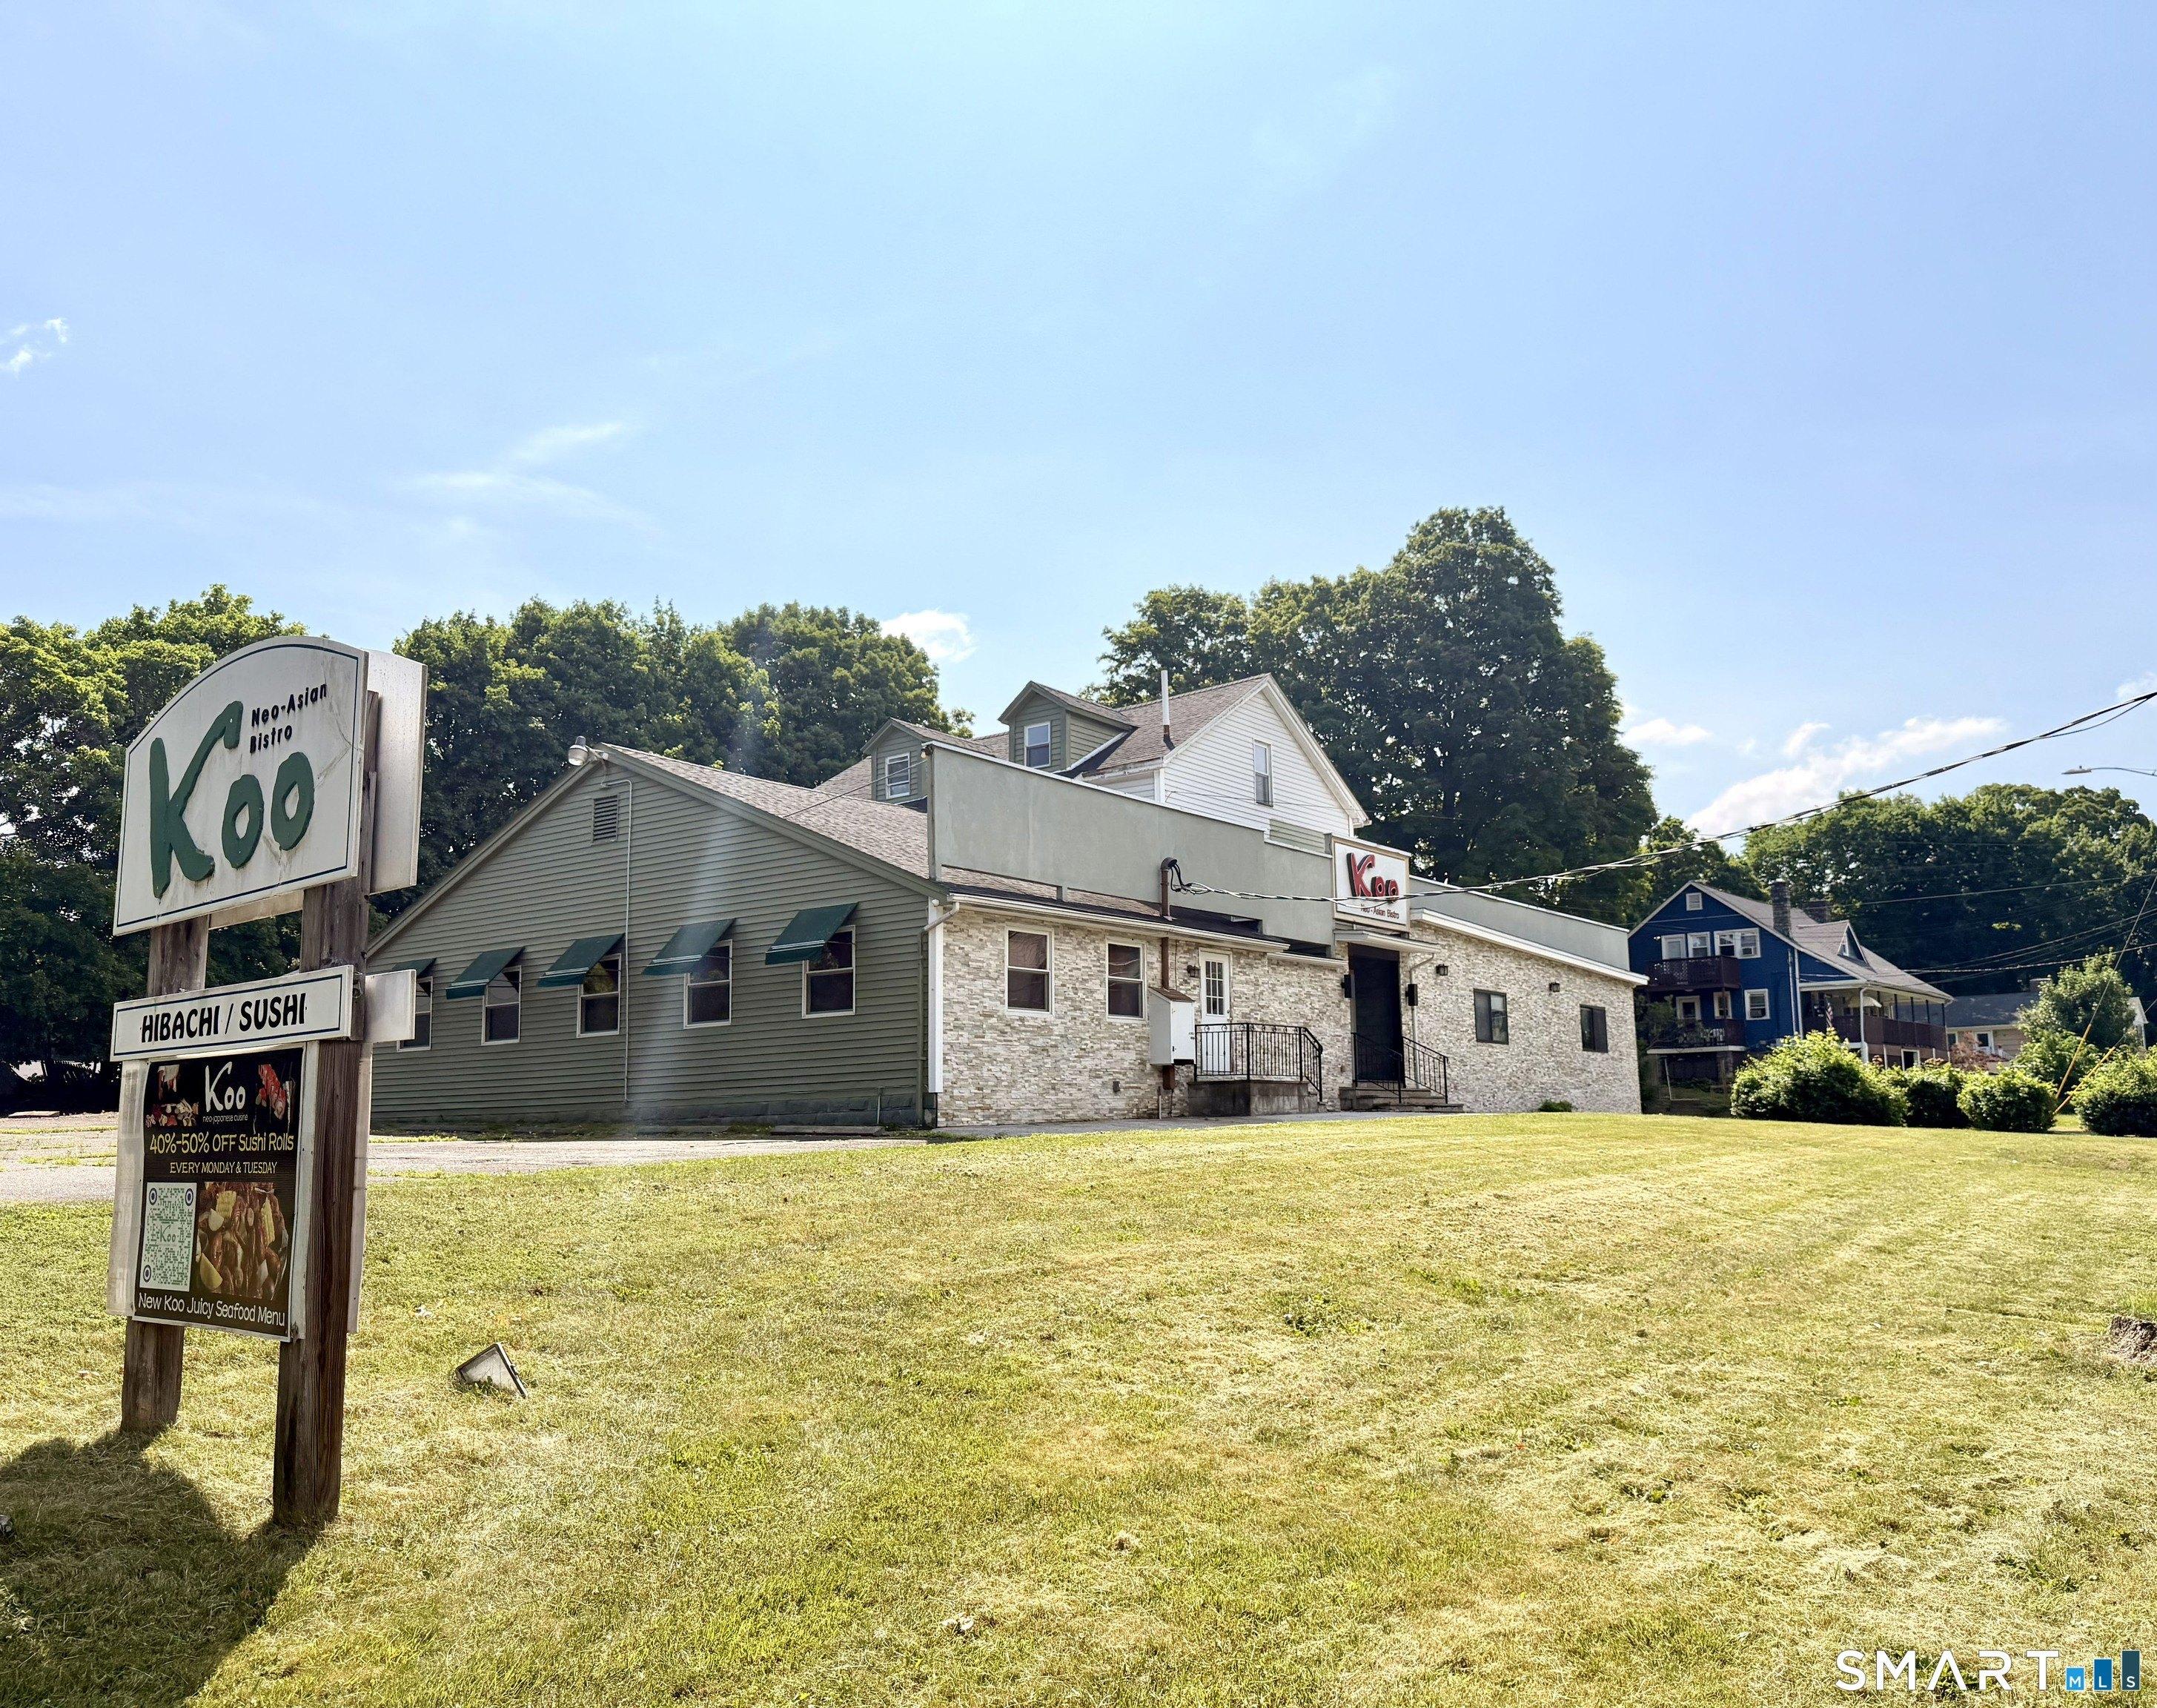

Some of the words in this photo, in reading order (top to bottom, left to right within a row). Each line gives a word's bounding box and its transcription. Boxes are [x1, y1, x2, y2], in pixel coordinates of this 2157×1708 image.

[251, 683, 327, 727] Neo-Asian
[250, 725, 293, 754] Bistro
[149, 701, 315, 898] Koo
[1347, 853, 1399, 902] Koo
[142, 1005, 220, 1042] HIBACHI
[239, 993, 306, 1032] SUSHI
[205, 1061, 246, 1112] Koo
[150, 1131, 210, 1153] 40%-50%
[212, 1133, 237, 1151] OFF
[238, 1132, 266, 1151] Sushi
[268, 1132, 294, 1151] Rolls
[169, 1162, 201, 1174] EVERY
[201, 1161, 235, 1174] MONDAY
[236, 1162, 242, 1174] &
[242, 1161, 278, 1174] TUESDAY
[160, 1224, 176, 1242] Koo
[138, 1292, 162, 1310] New
[164, 1294, 185, 1312] Koo
[187, 1297, 214, 1320] Juicy
[215, 1300, 256, 1322] Seafood
[258, 1305, 285, 1326] Menu
